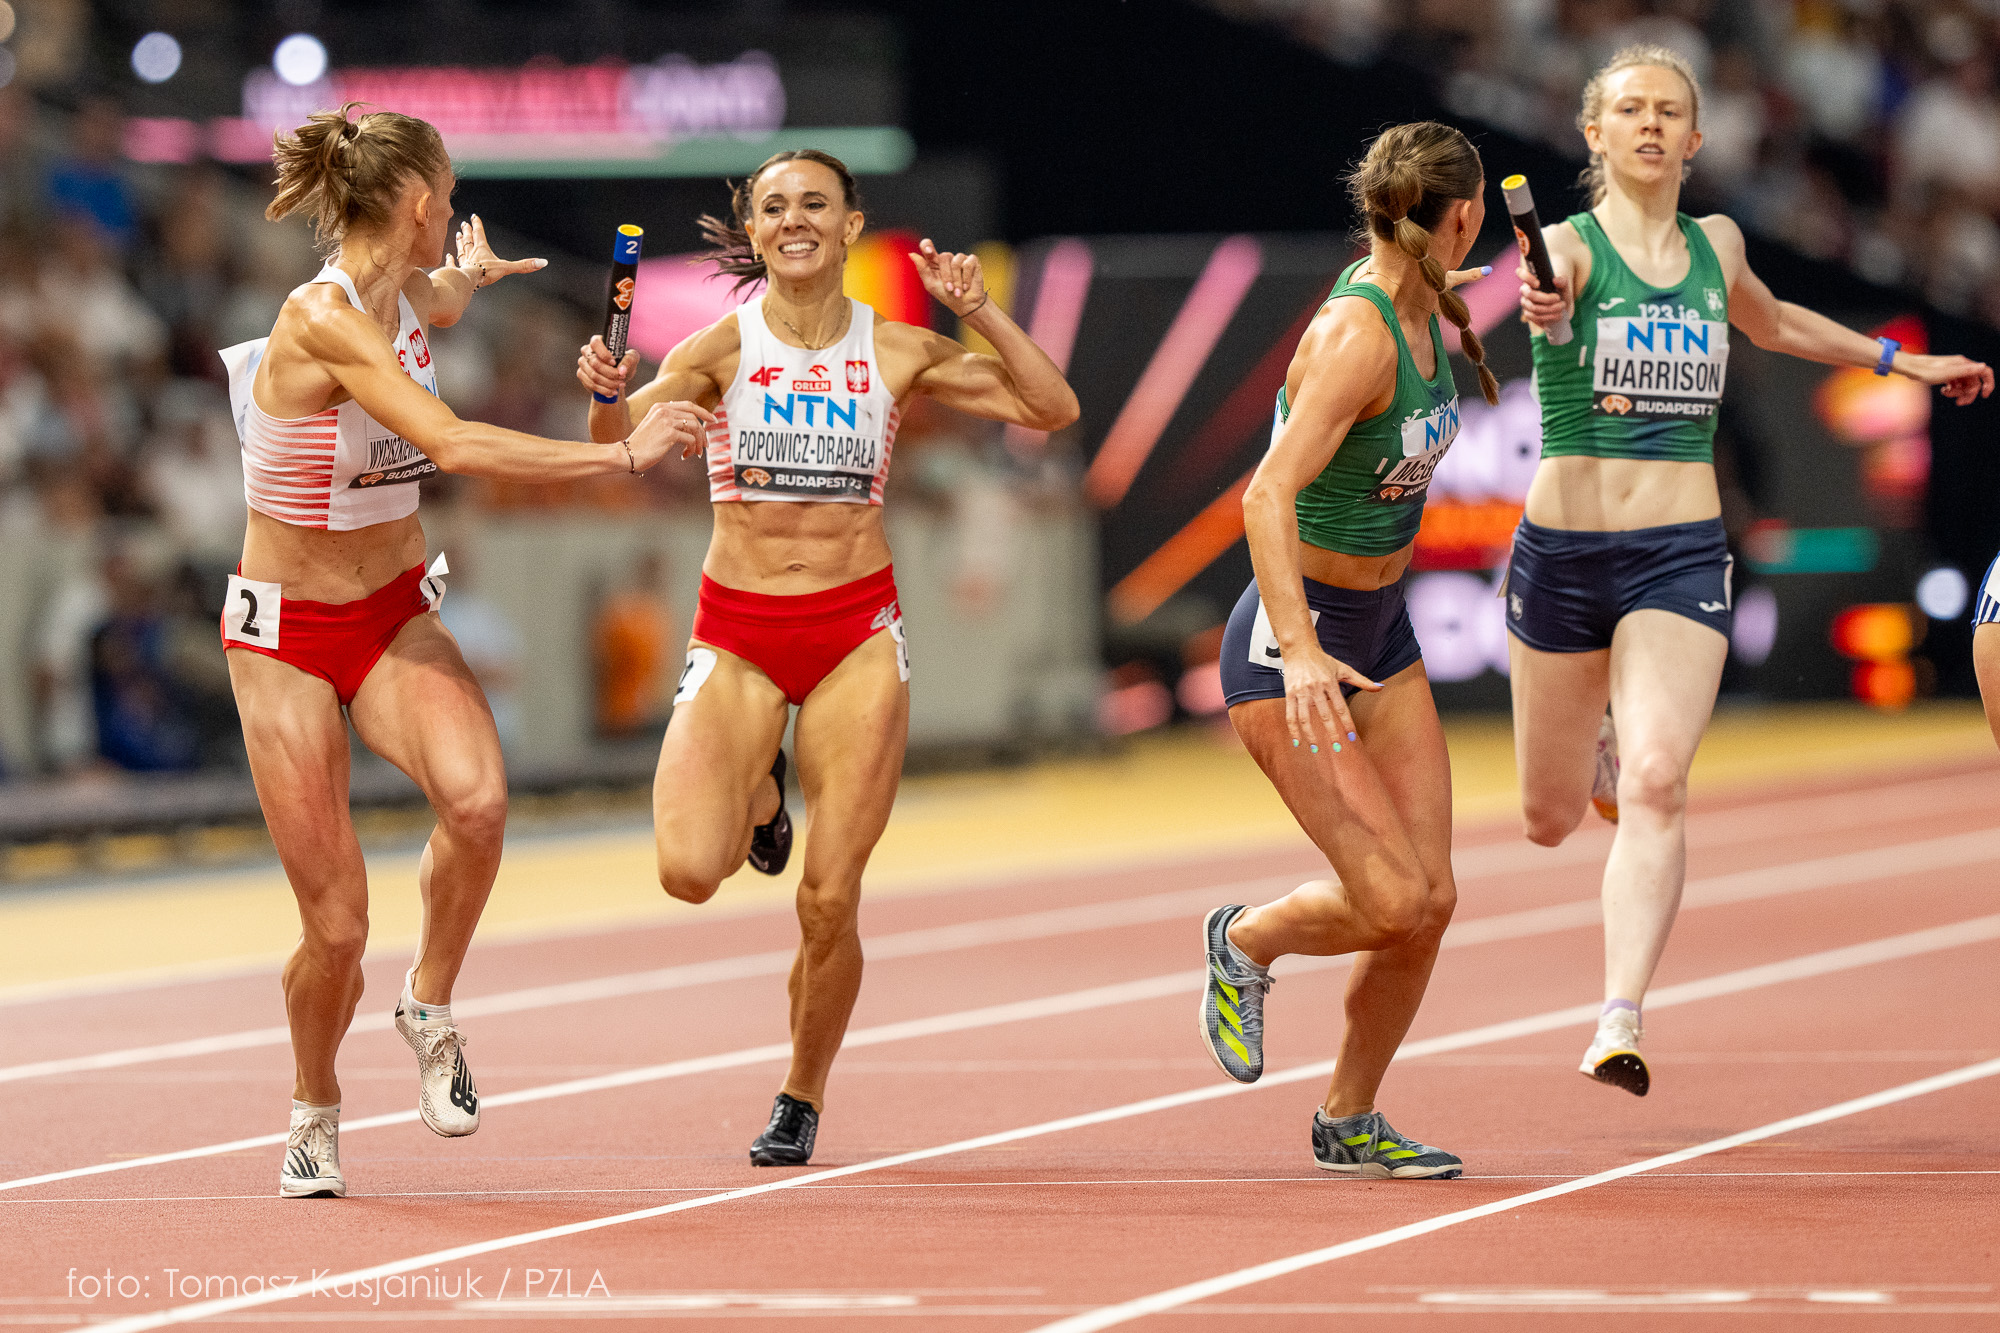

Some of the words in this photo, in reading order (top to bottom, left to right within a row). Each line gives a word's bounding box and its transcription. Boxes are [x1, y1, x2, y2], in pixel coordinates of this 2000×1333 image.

[626, 240, 638, 254] 2
[609, 314, 619, 350] BUDAPEST
[1627, 321, 1708, 355] NTN
[749, 366, 784, 387] 4F
[794, 382, 829, 391] ORLEN
[1603, 358, 1720, 392] HARRISON
[764, 392, 856, 431] NTN
[1425, 396, 1459, 451] NTN
[1636, 401, 1706, 415] BUDAPEST
[738, 430, 876, 470] POPOWICZ-DRAPAŁA
[775, 473, 848, 488] BUDAPEST
[240, 588, 260, 638] 2
